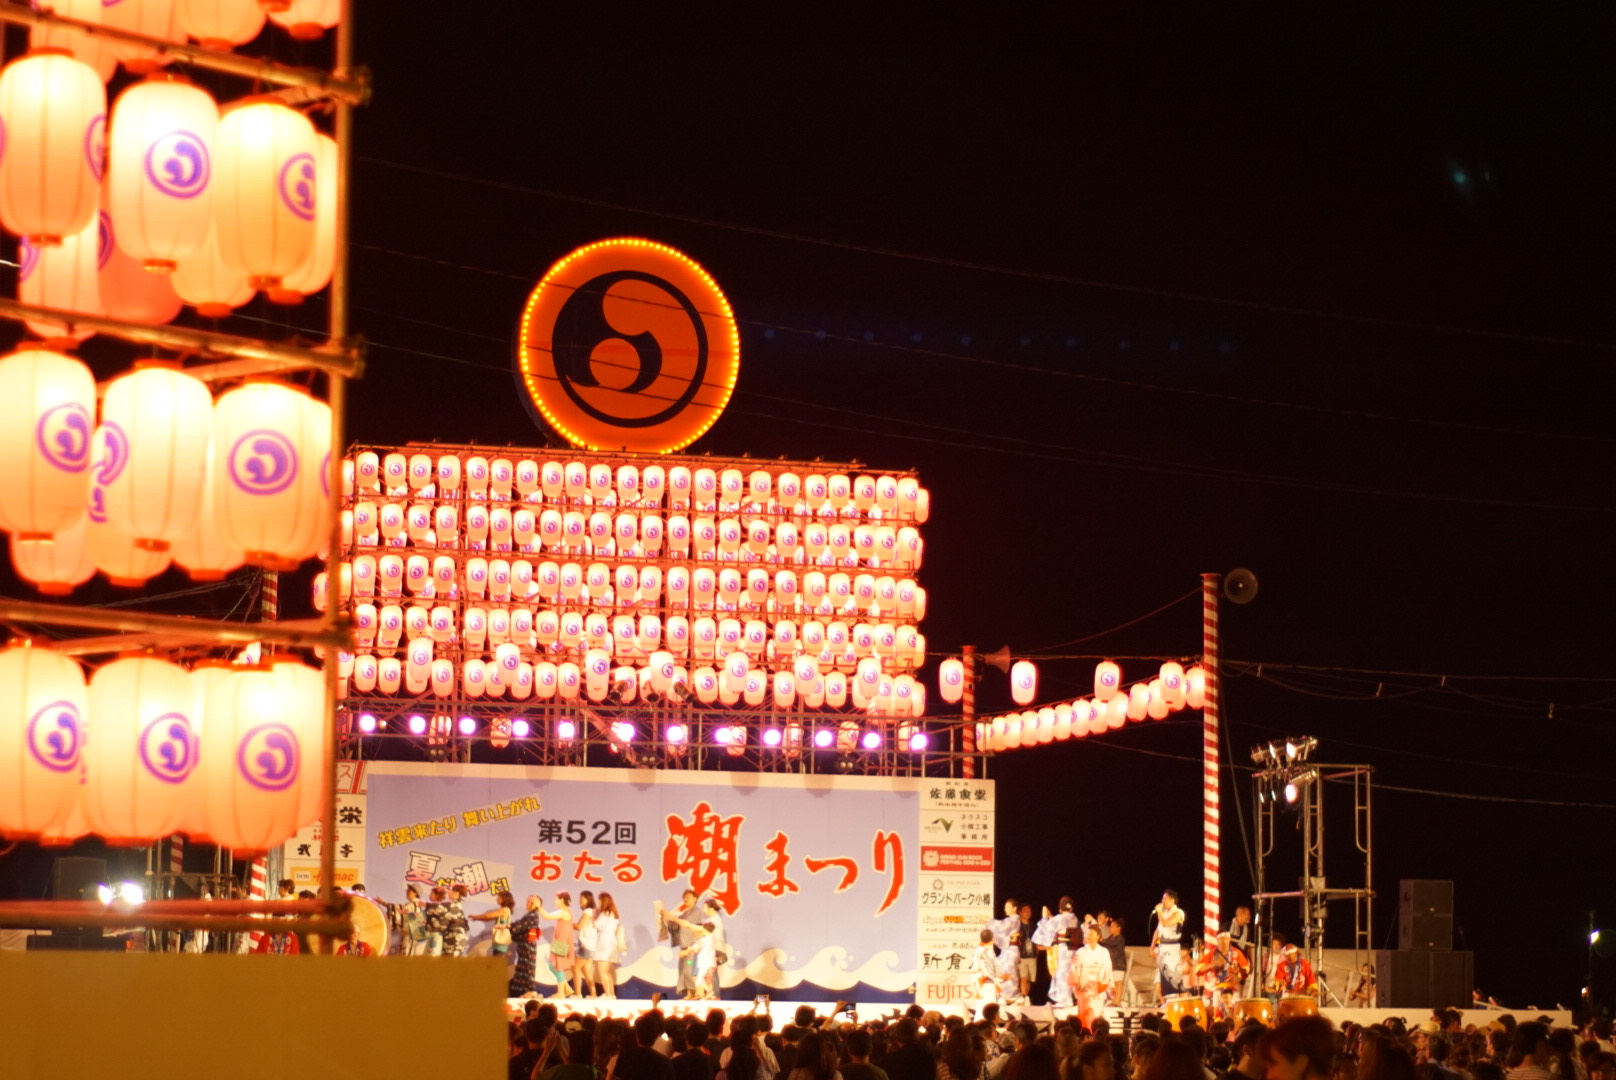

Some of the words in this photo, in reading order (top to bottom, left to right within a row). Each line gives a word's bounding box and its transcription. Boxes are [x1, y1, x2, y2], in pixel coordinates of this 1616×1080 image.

[378, 815, 458, 849] 祥雲来たり
[461, 796, 541, 828] 舞い上がれ
[538, 818, 637, 845] 第52回
[530, 850, 643, 883] おたる
[662, 801, 905, 918] 潮まつり
[922, 891, 991, 907] グランドパーク小樽
[922, 952, 974, 971] 新倉
[927, 984, 973, 1004] FUJITS
